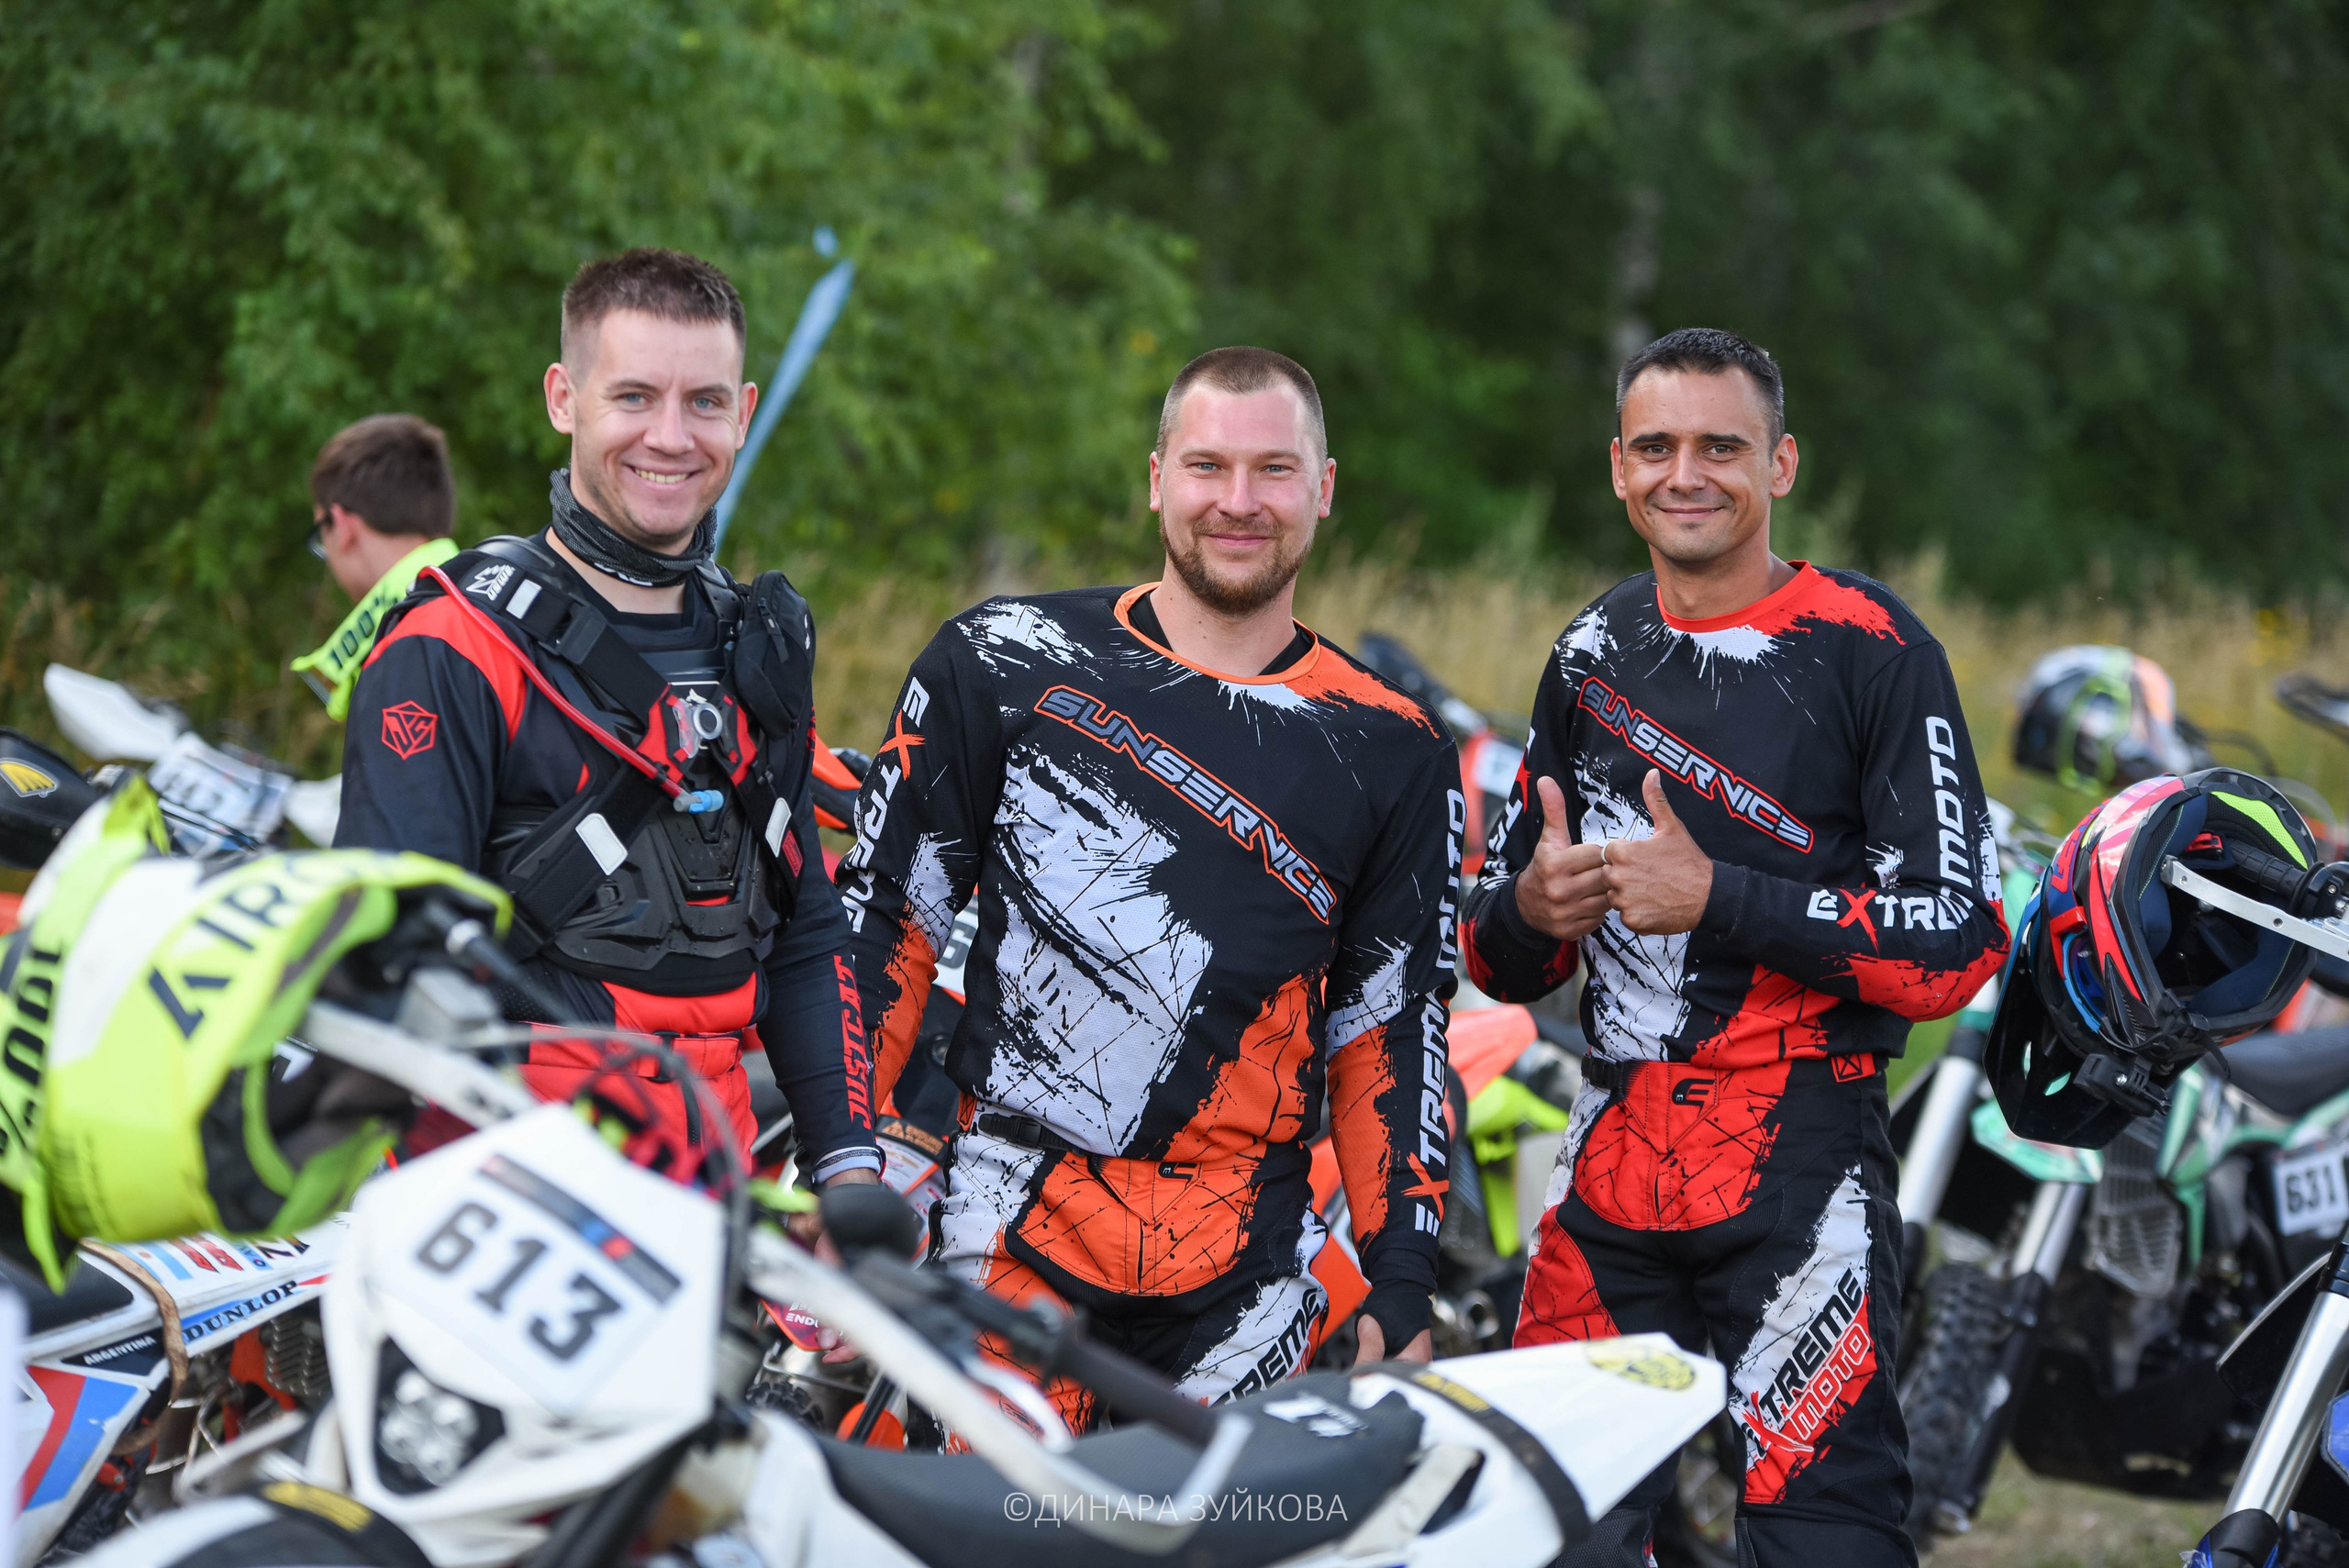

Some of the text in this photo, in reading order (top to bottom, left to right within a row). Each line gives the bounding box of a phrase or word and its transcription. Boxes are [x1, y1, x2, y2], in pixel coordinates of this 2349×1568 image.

[1038, 687, 1335, 921] SUNSERVICE
[1580, 680, 1812, 850] SUNSERVICE
[1925, 716, 1973, 888] MOTO
[83, 1335, 156, 1366] ARGENTINA
[185, 1279, 298, 1342] DUNLOP
[417, 1203, 622, 1362] 613
[1788, 1322, 1871, 1441] MOTO
